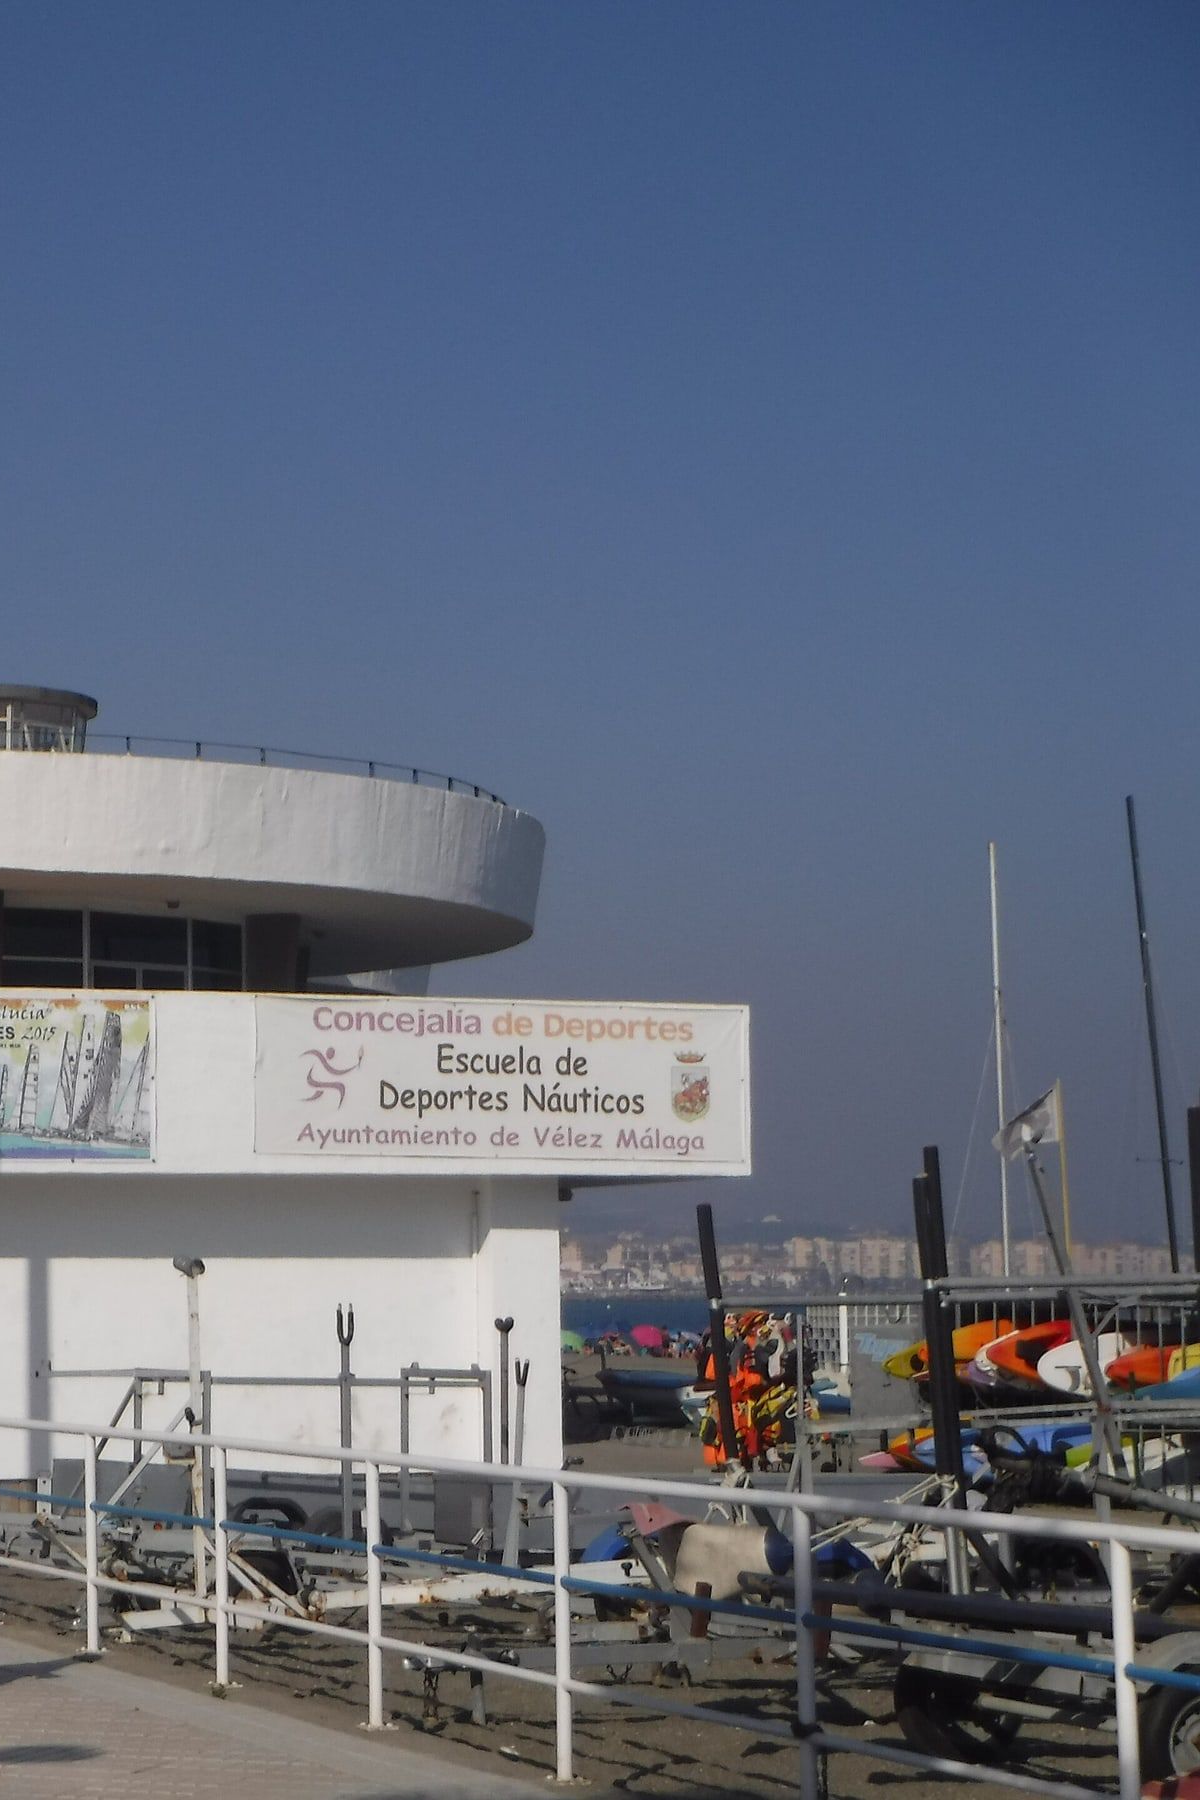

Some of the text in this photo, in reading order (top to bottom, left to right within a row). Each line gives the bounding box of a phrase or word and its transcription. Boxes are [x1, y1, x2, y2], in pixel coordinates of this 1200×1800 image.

[20, 1026, 57, 1041] 2015
[312, 1006, 695, 1042] Concejalía de Deportes
[436, 1043, 589, 1076] Escuela de
[378, 1079, 646, 1119] Deportes Náuticos
[296, 1122, 705, 1156] Ayuntamiento de Vélez Málaga
